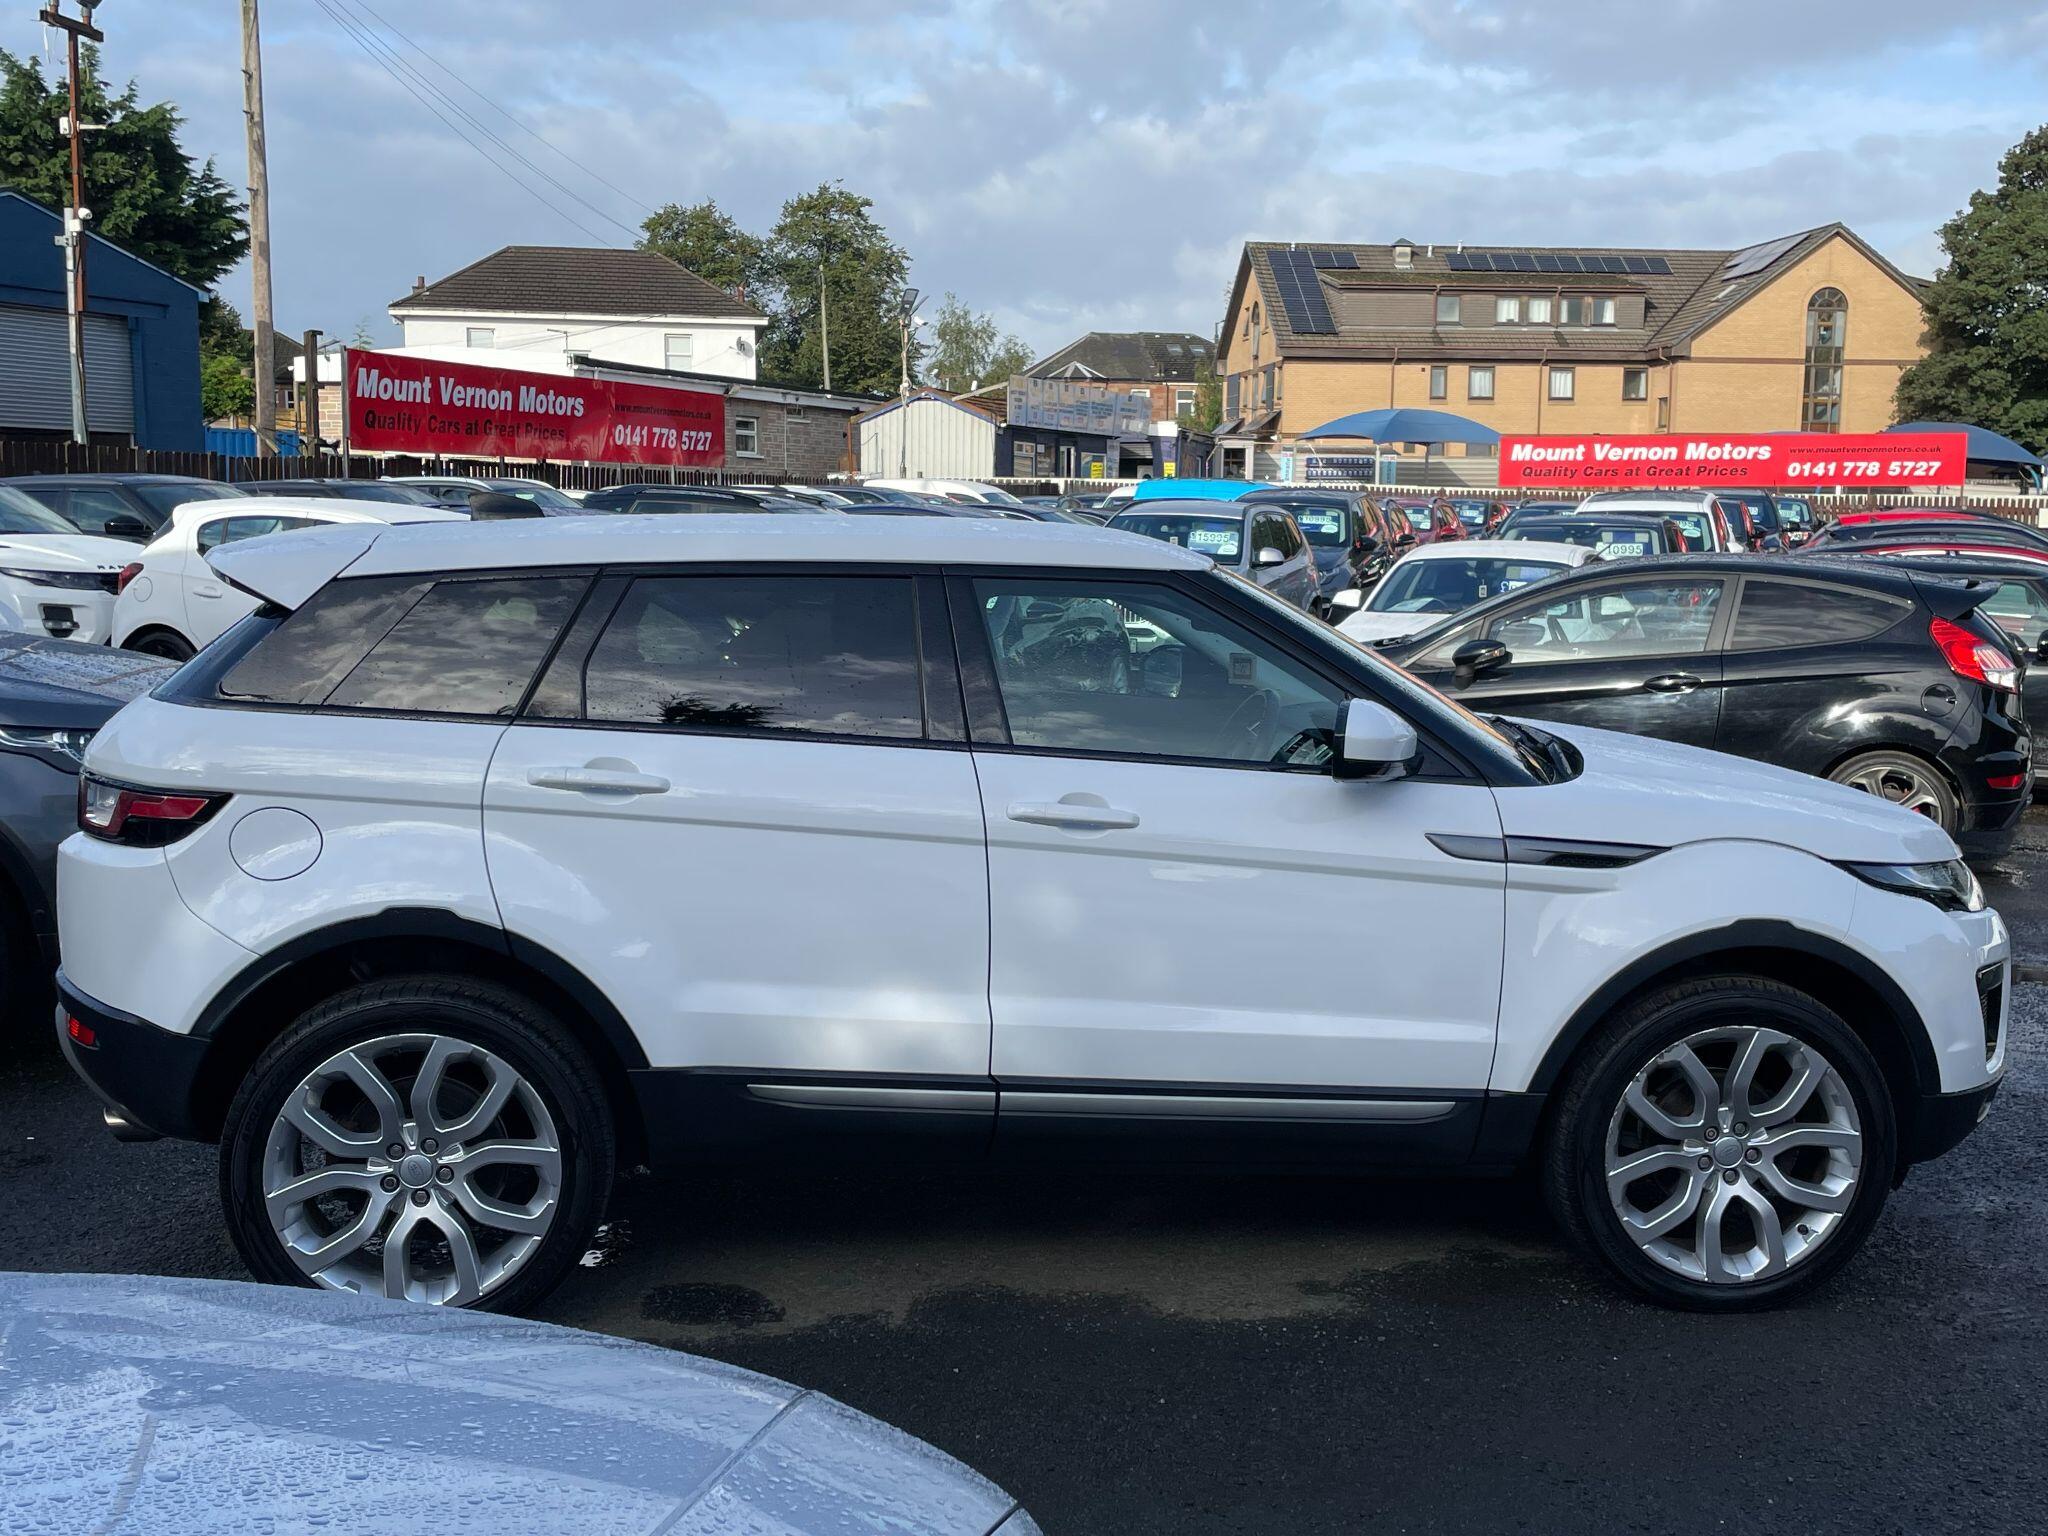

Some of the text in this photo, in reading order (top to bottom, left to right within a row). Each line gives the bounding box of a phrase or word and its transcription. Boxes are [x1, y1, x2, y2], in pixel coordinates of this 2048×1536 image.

[356, 367, 585, 417] Mount Vernon Motors
[364, 409, 565, 440] Quality Cars at Great Prices
[615, 424, 713, 451] 0141 778 5727
[1510, 442, 1772, 462] Mount Vernon Motors
[1788, 445, 1942, 454] www.mountvernonmotors.co.uk
[1522, 465, 1749, 480] Quality Cars at Great Prices
[1786, 461, 1942, 477] 0141 778 5727
